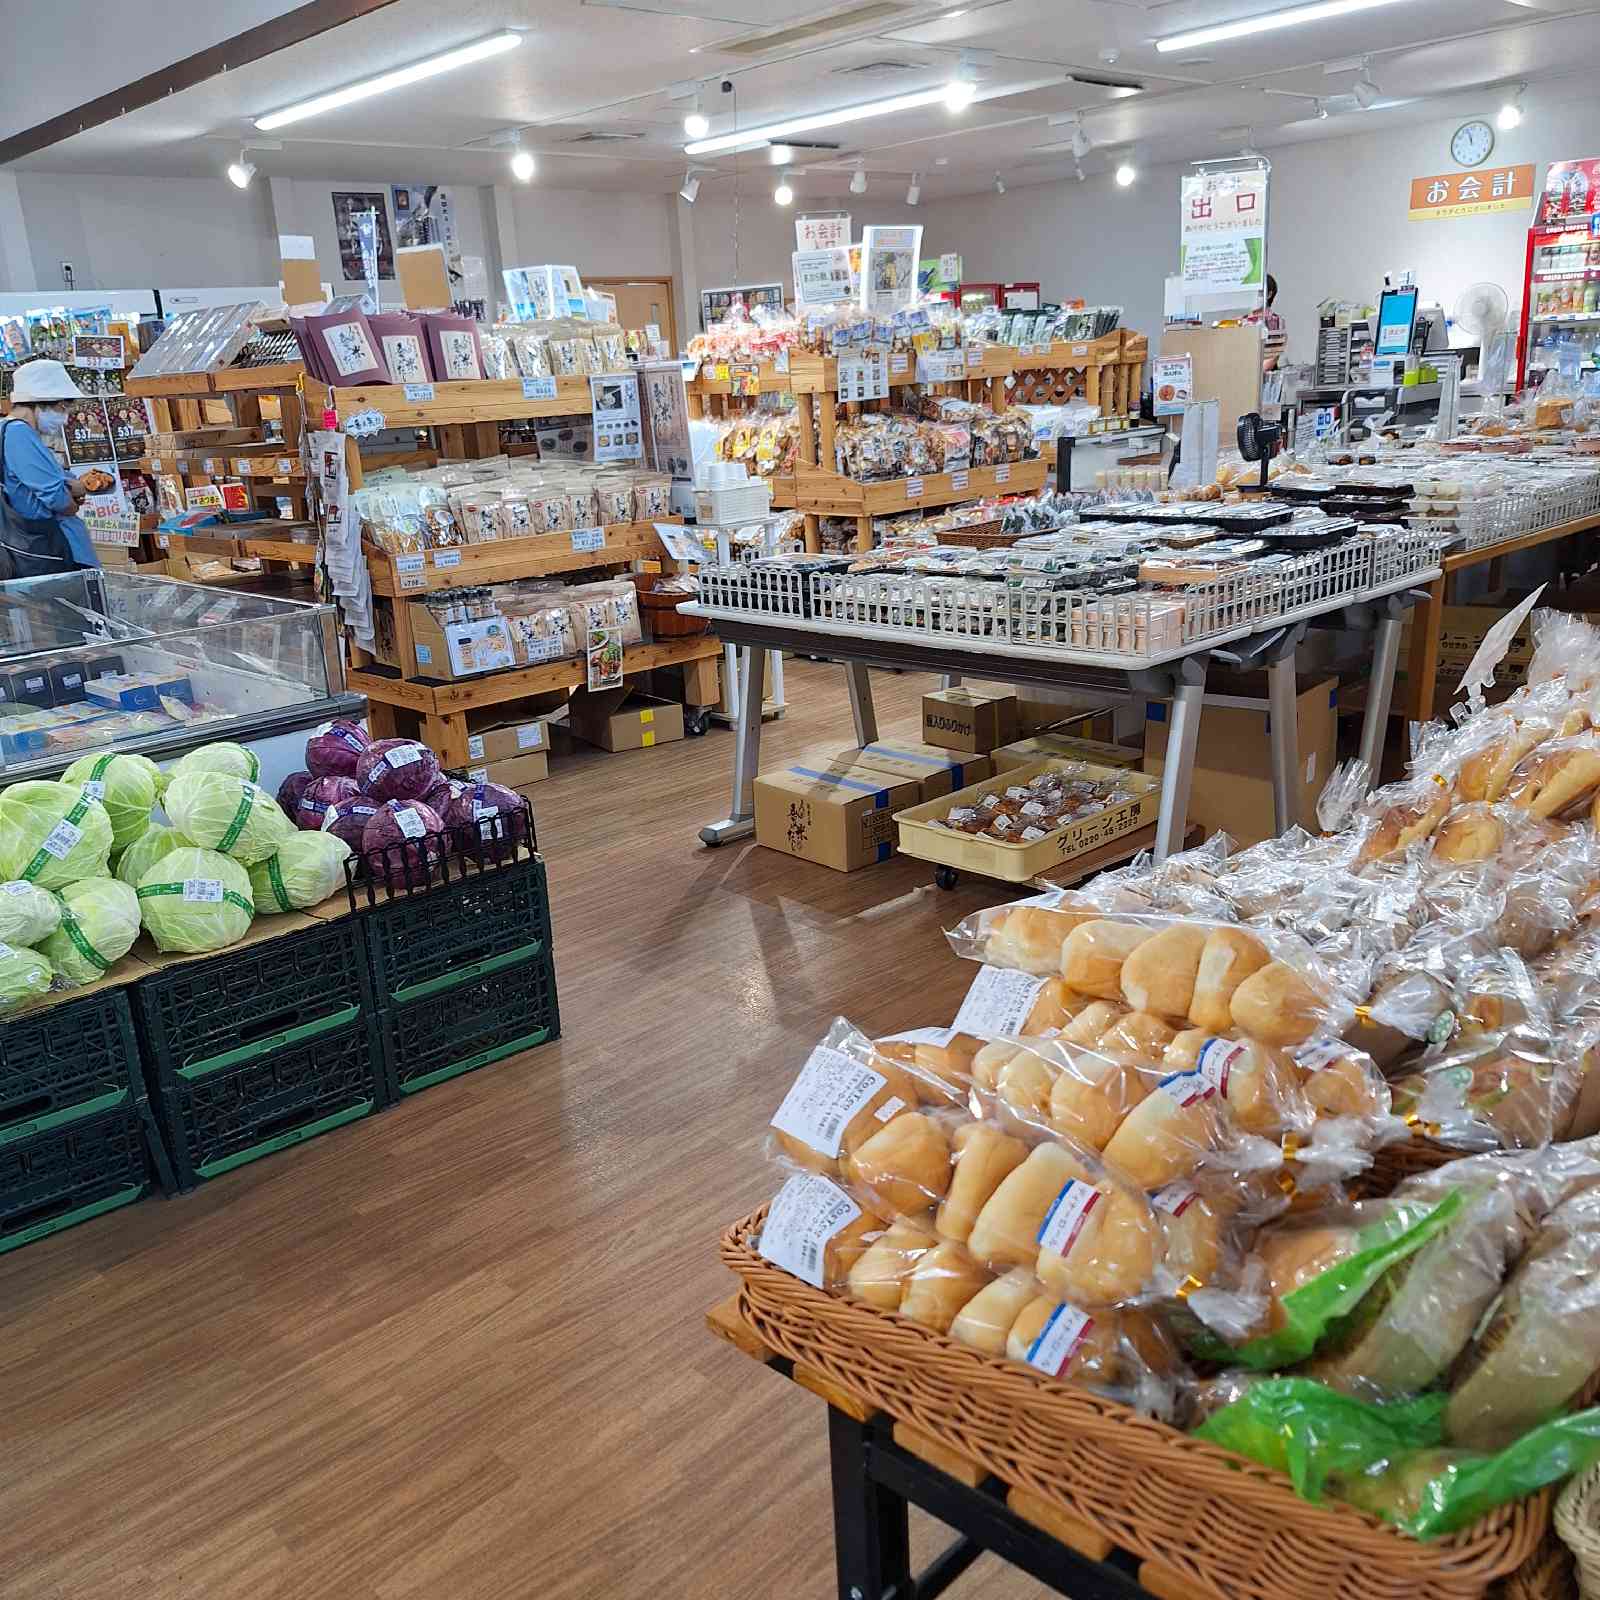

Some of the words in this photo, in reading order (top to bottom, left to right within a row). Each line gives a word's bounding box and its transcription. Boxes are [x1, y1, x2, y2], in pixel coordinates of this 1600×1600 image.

[1427, 171, 1519, 203] お会計
[1191, 191, 1255, 219] 出口
[804, 223, 842, 239] お会計
[96, 503, 120, 518] BIG
